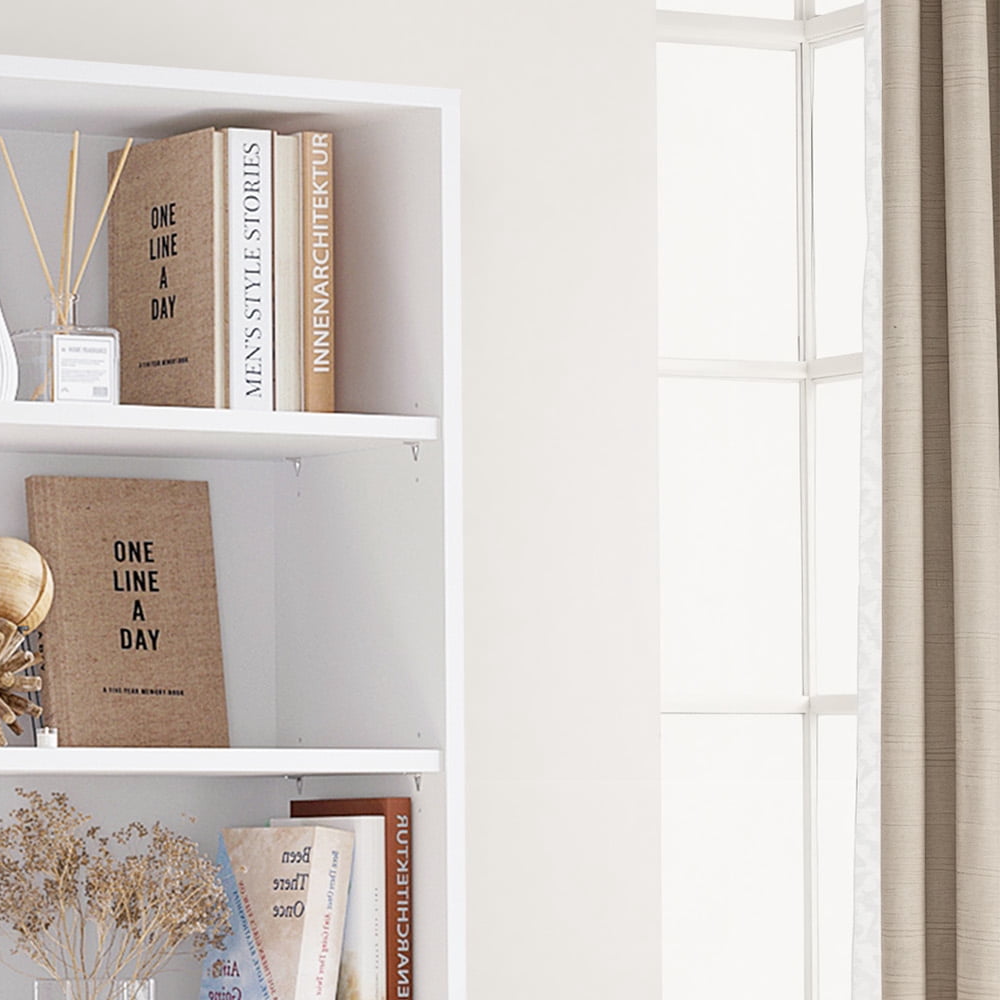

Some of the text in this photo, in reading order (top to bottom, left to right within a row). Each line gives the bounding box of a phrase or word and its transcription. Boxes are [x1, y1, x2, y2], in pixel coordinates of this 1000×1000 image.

[151, 203, 176, 229] ONE
[149, 233, 178, 261] LINE
[312, 133, 330, 373] INNENARCHITEKTUR
[159, 266, 168, 289] A
[243, 142, 262, 398] MEN'S STYLE STORIES
[151, 295, 176, 320] DAY
[113, 540, 155, 563] ONE
[112, 570, 160, 592] LINE
[132, 599, 145, 621] A
[120, 628, 160, 651] DAY
